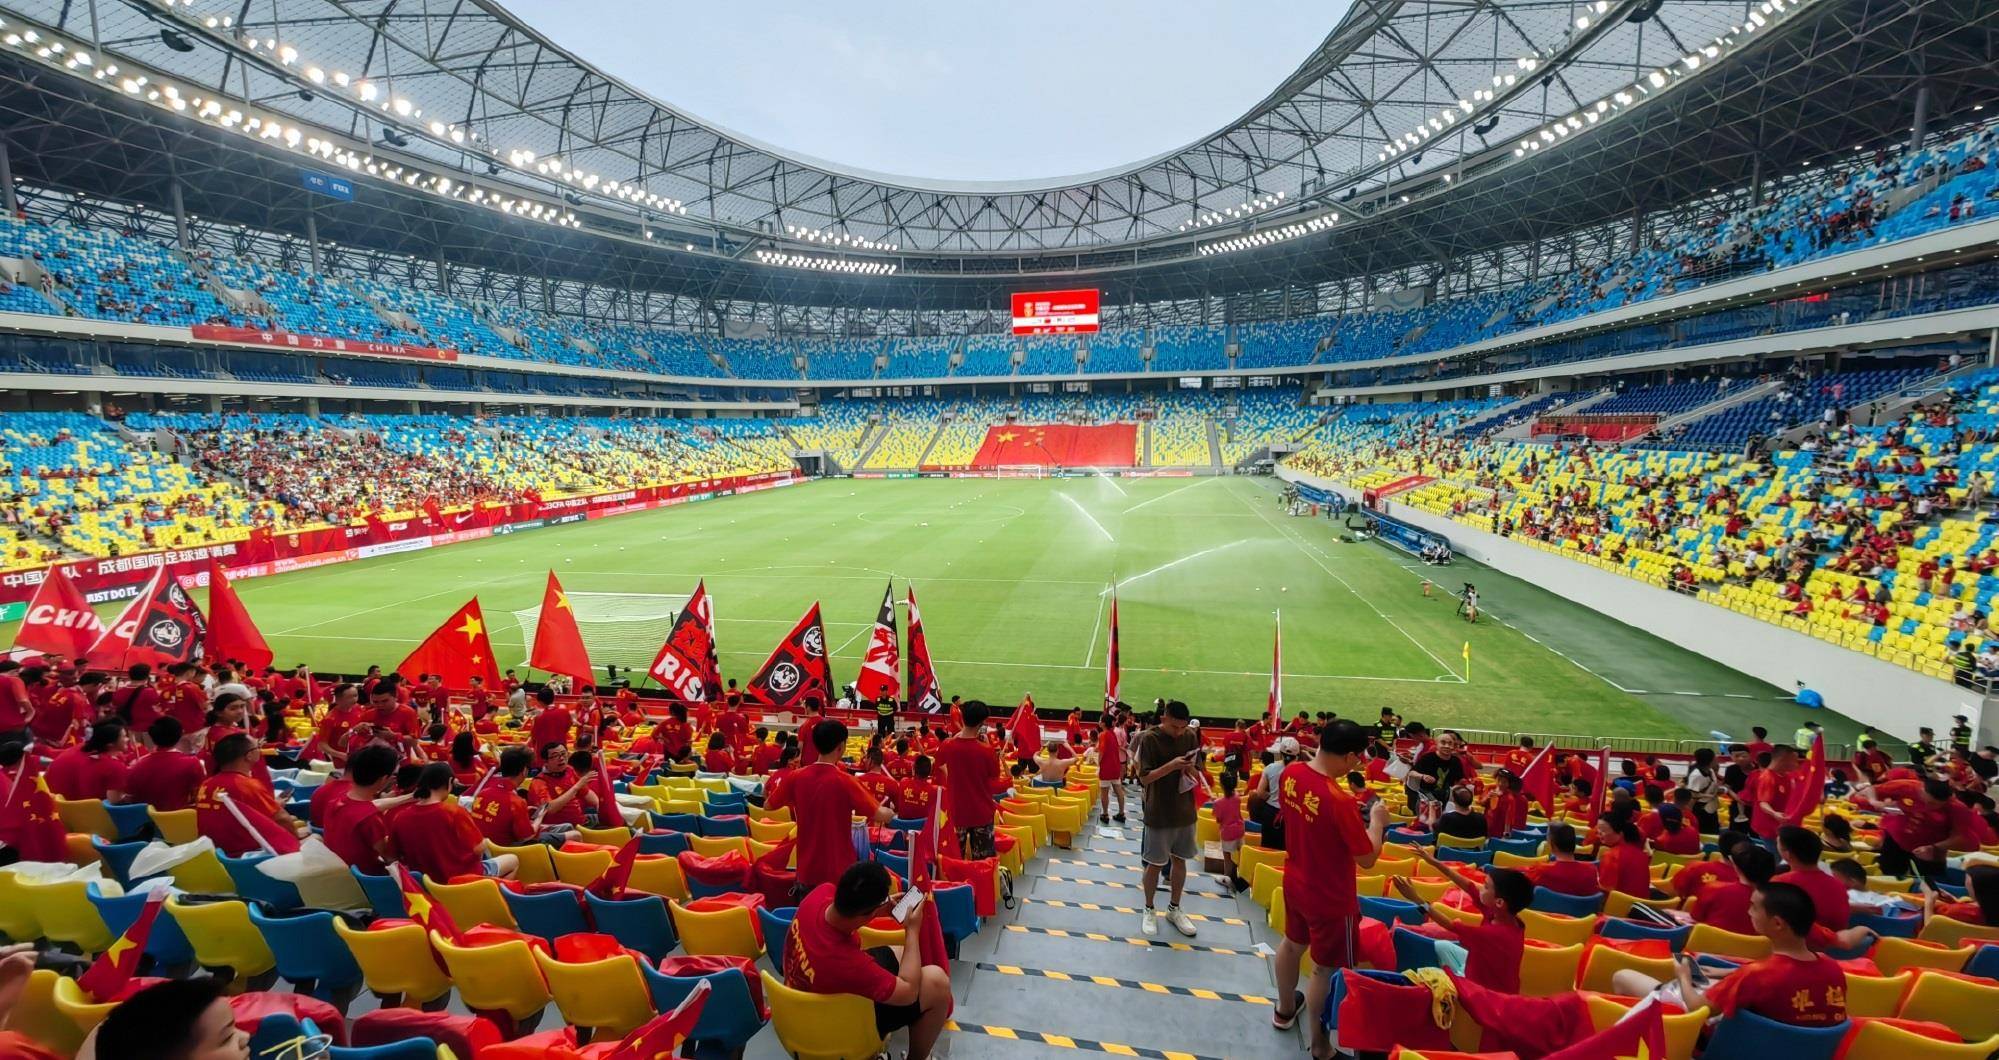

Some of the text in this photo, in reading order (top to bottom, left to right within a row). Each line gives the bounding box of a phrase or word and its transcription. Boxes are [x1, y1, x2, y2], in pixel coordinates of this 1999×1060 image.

[368, 343, 405, 354] CHINA
[3, 566, 82, 588] 中国队
[85, 590, 109, 603] JUST
[110, 588, 126, 600] DO
[791, 918, 815, 984] CHINA
